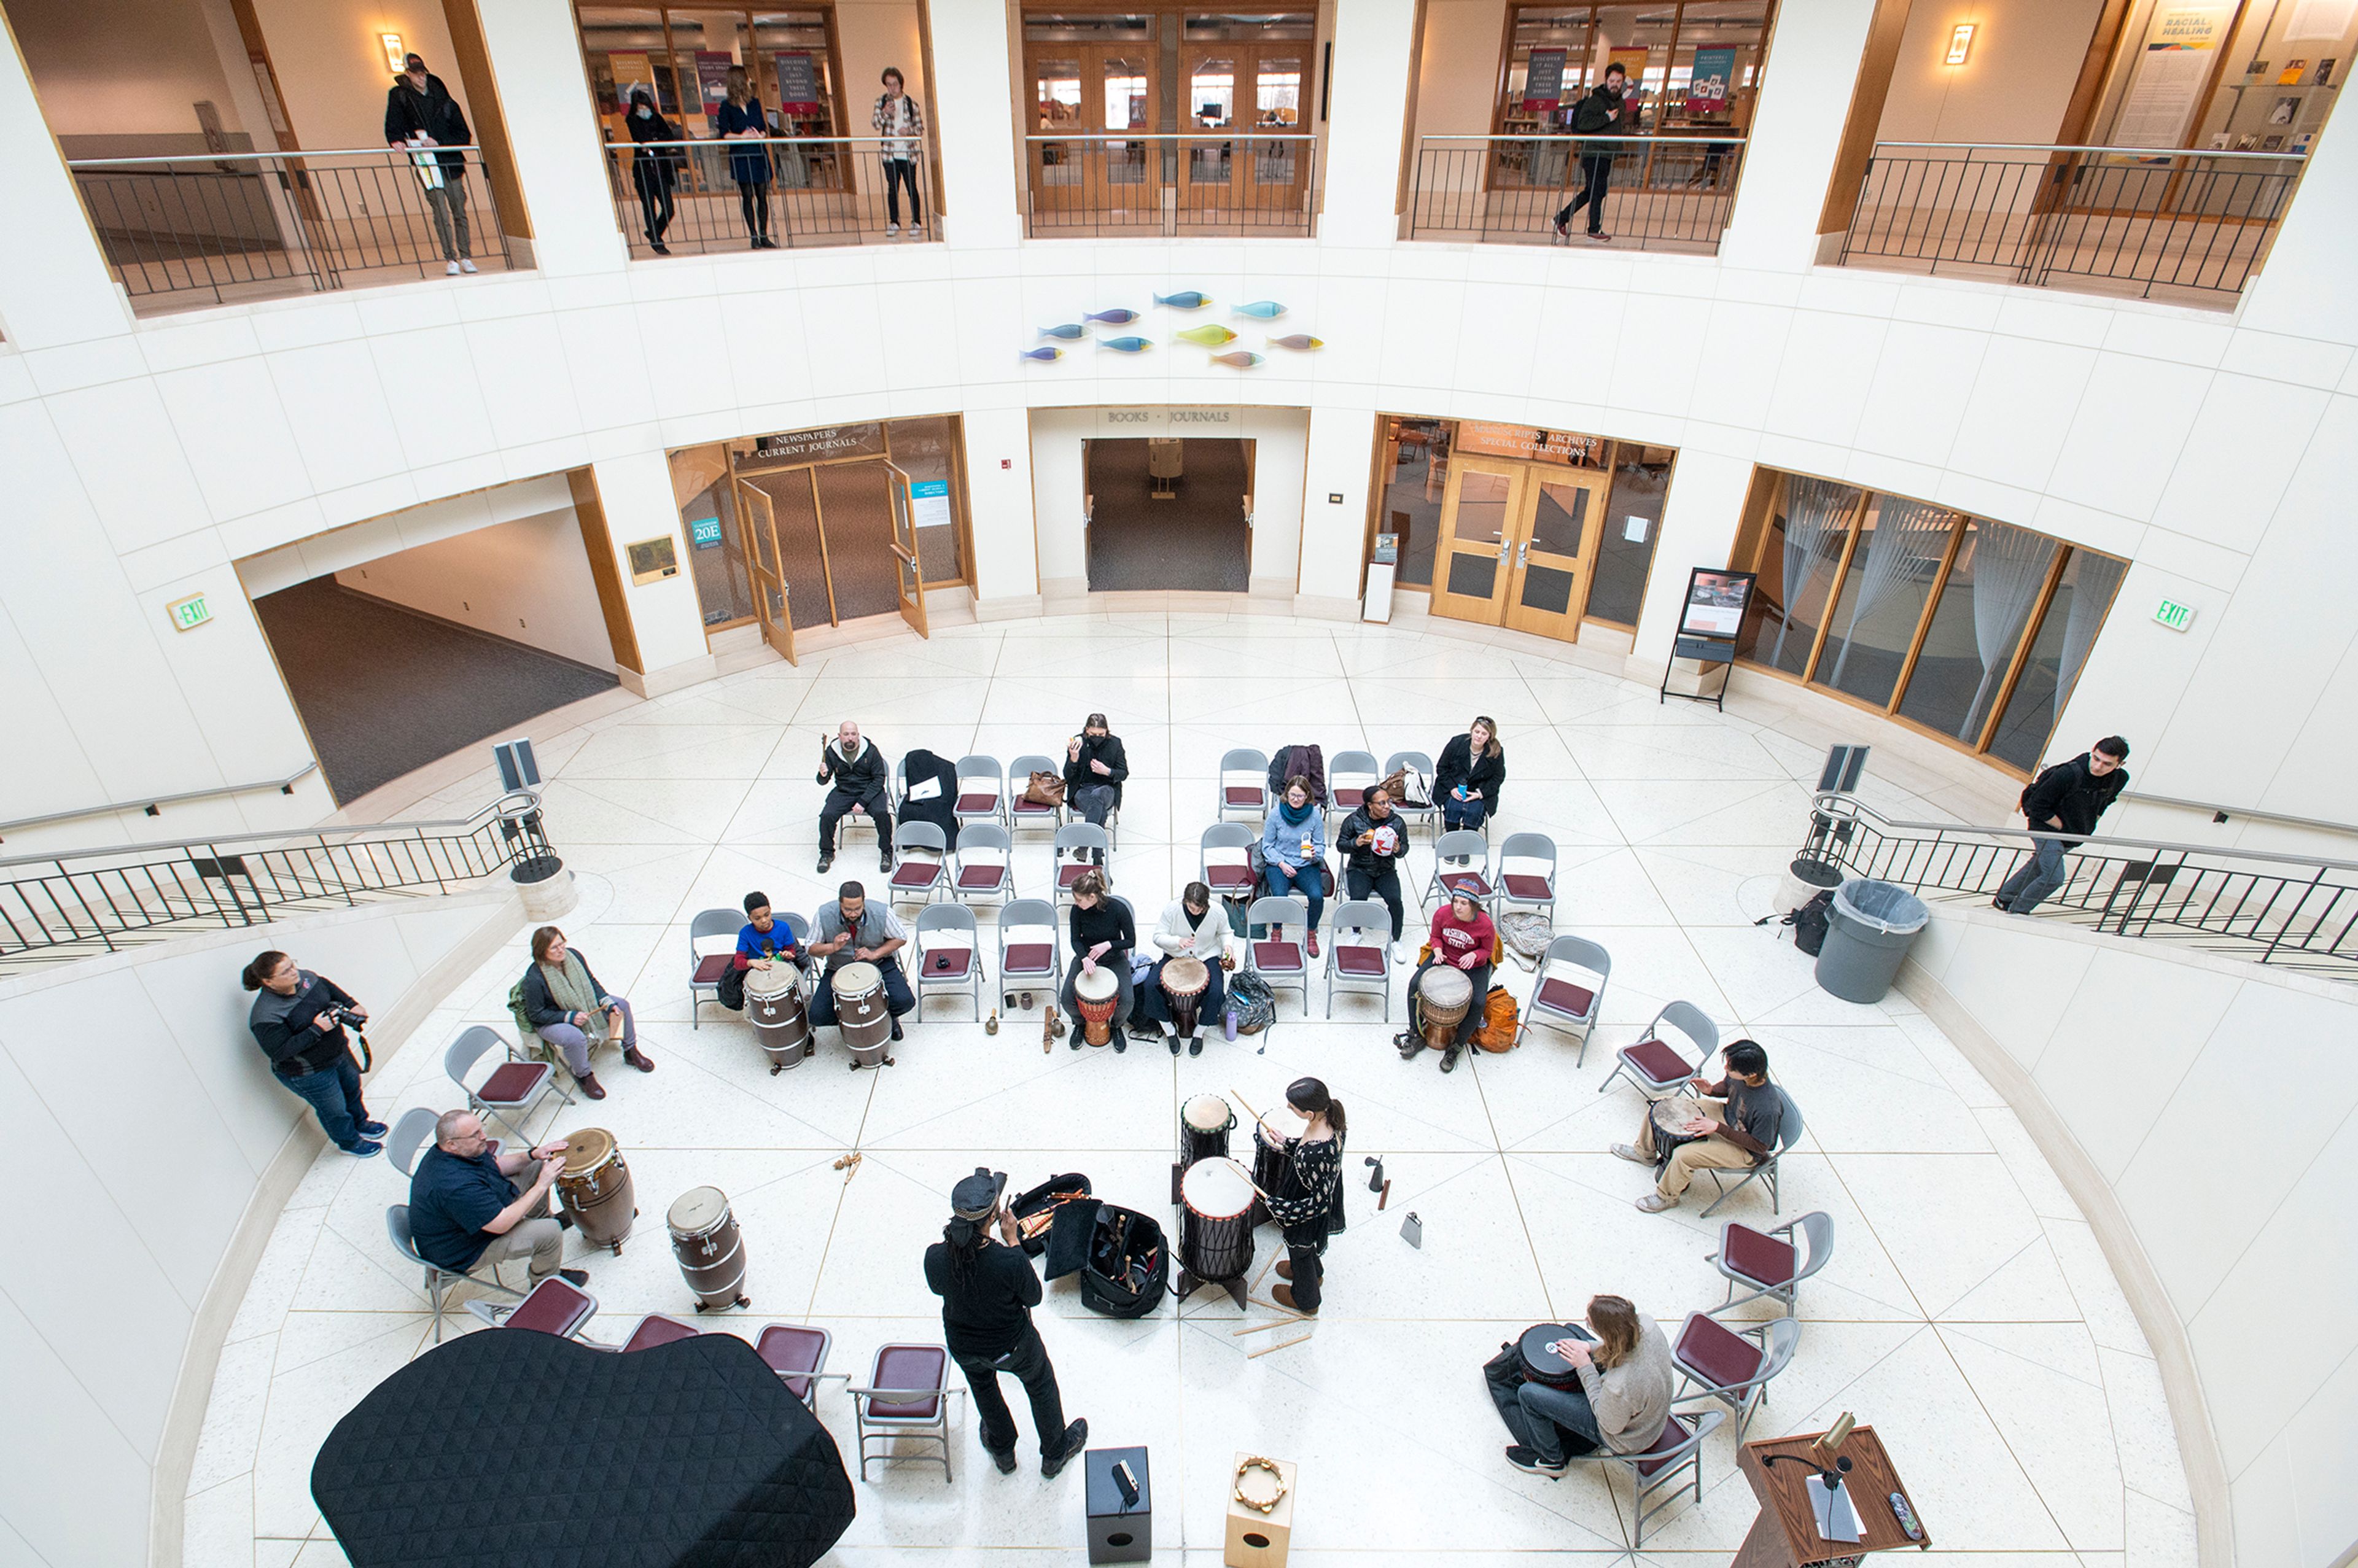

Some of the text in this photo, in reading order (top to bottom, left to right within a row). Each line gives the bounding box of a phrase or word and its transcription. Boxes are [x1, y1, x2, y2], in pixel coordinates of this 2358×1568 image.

[2165, 17, 2206, 26] RACIAL
[2162, 26, 2213, 35] HEALING
[1108, 412, 1230, 423] BOOKS JOURNALS
[775, 429, 837, 444] NEWSPAPERS
[1474, 424, 1598, 447] MANUSCRIPTS ARCHIVES
[758, 437, 857, 459] CURRENT JOURNALS
[1481, 437, 1586, 457] SPECIAL COLLECTIONS
[695, 525, 720, 540] 20E
[179, 598, 209, 624] EXIT
[2156, 600, 2189, 627] EXIT
[1442, 927, 1475, 945] WASHINGTON
[1448, 936, 1466, 950] STATE
